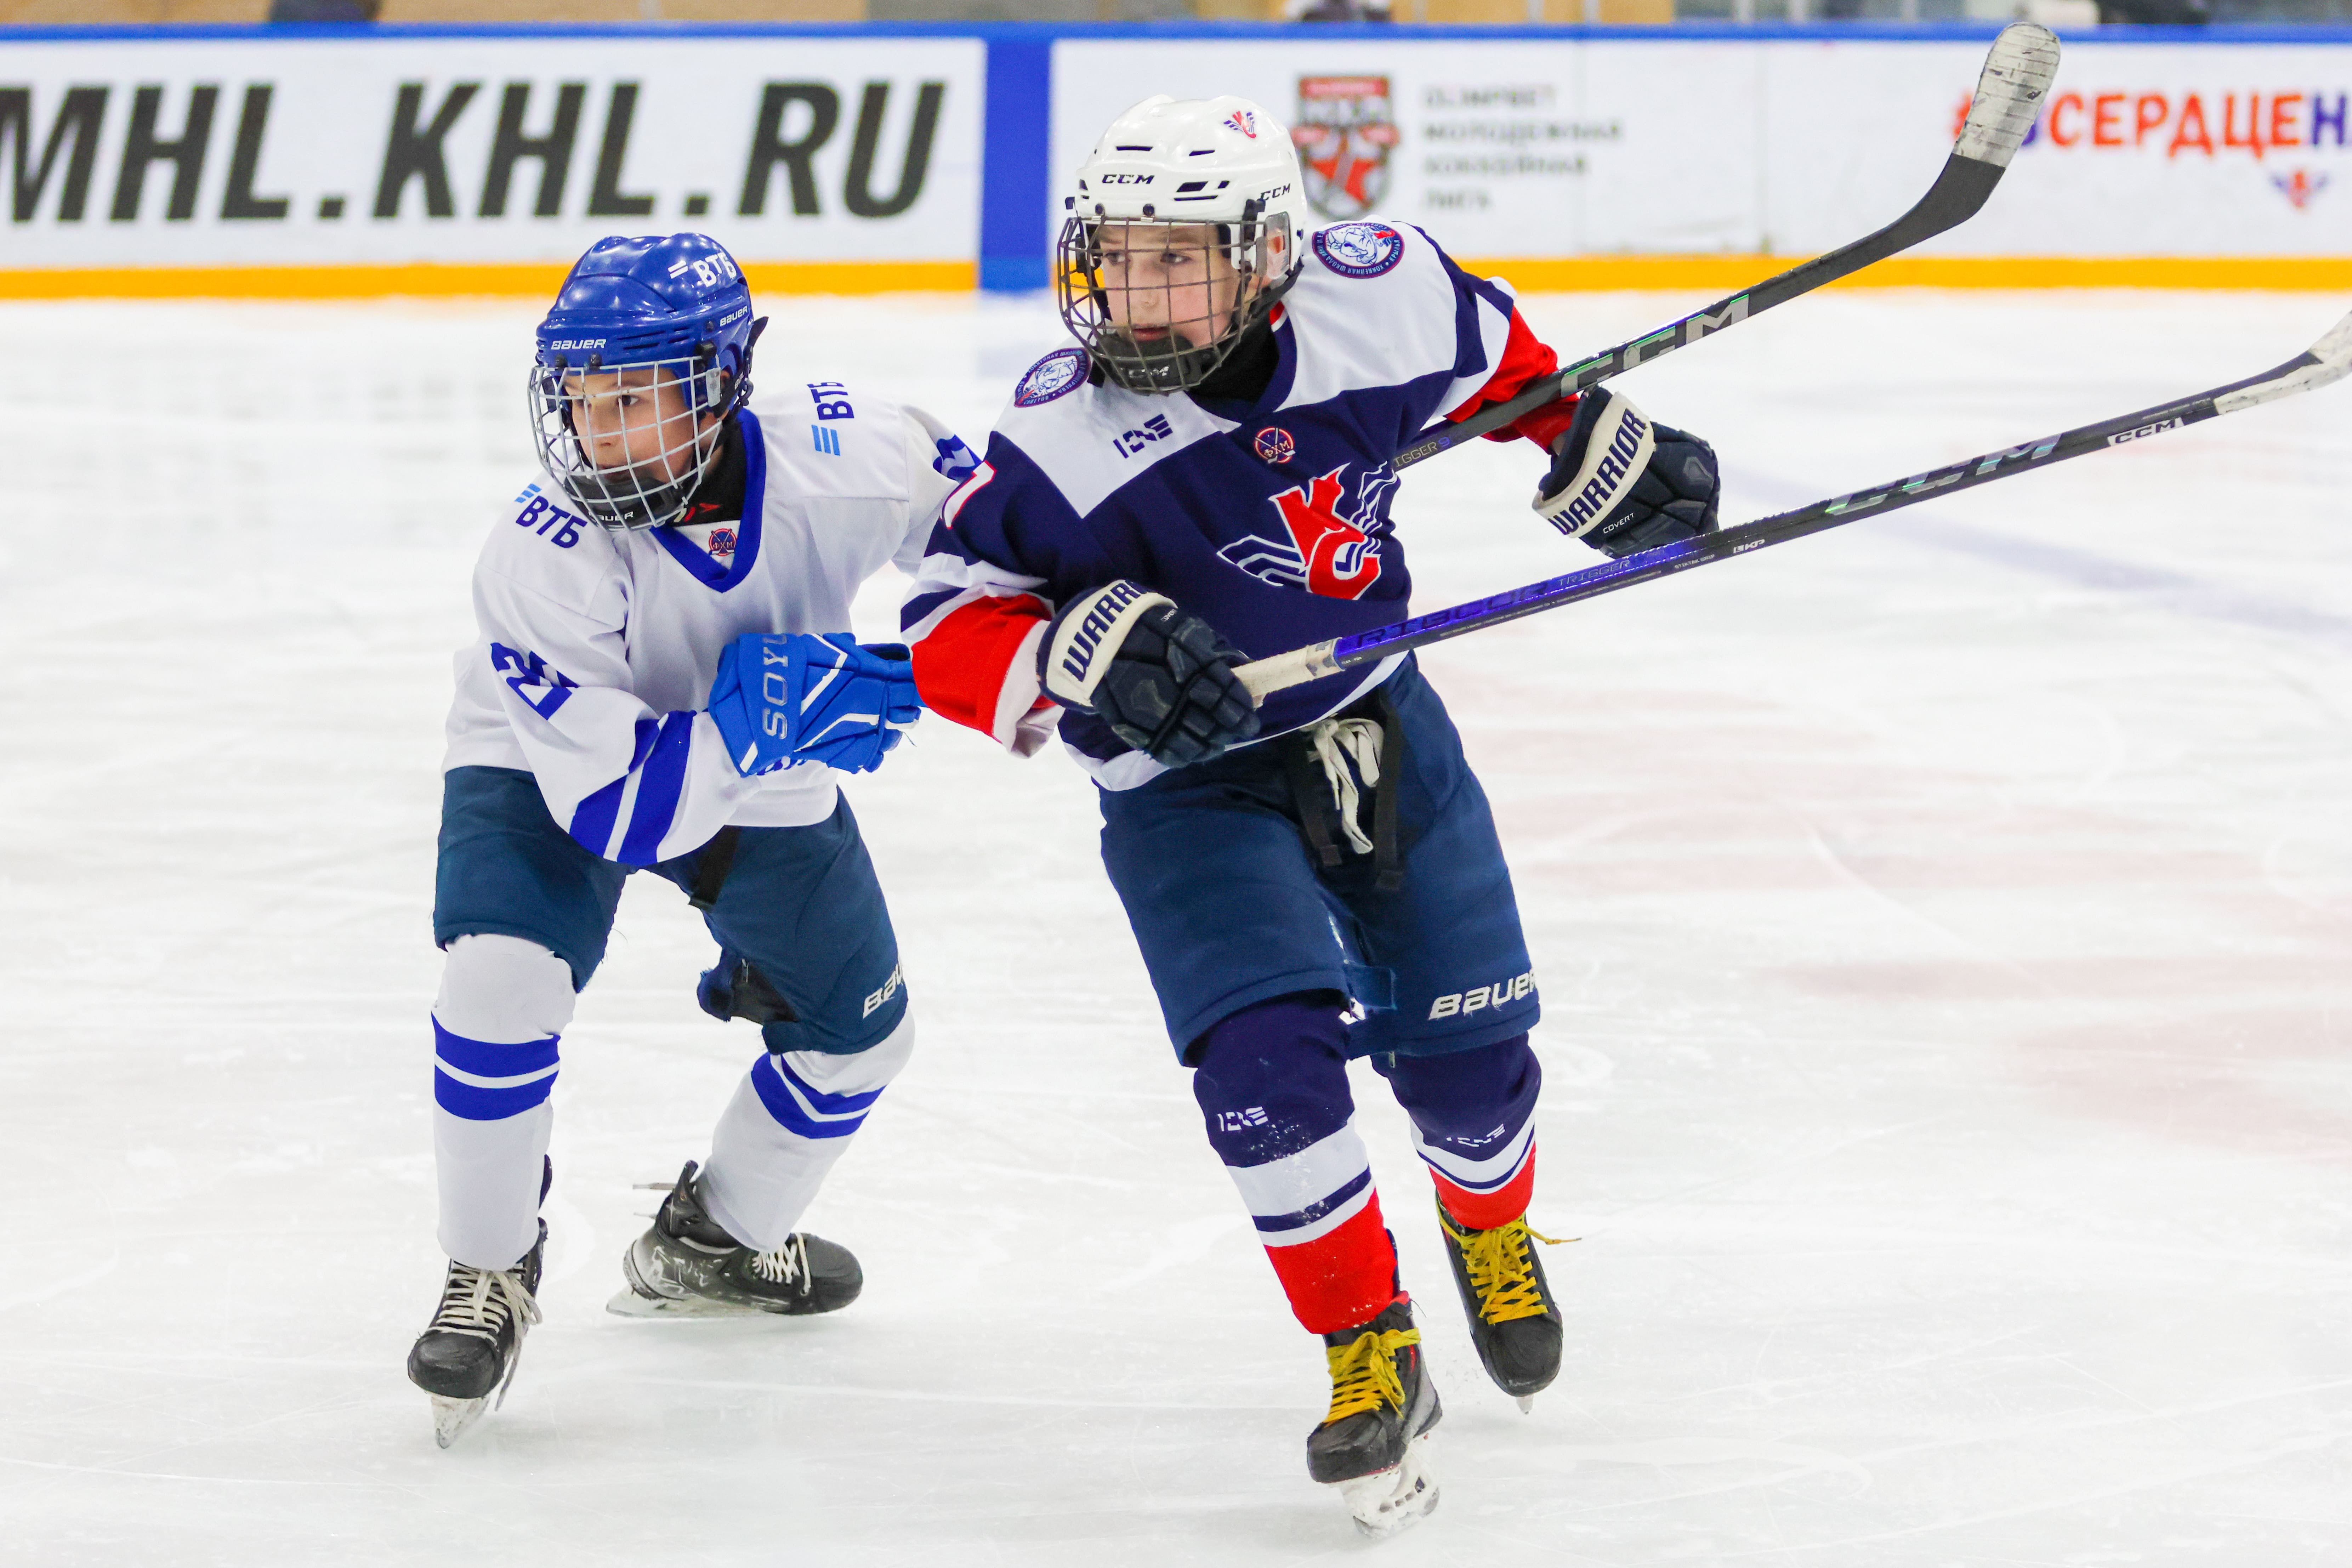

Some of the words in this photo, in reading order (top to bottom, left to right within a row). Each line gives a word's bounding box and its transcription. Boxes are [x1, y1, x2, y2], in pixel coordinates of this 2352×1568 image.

[1101, 174, 1155, 184] CCM
[1260, 183, 1291, 201] CCM
[693, 251, 737, 287] ВТБ
[720, 306, 748, 326] BAUER
[551, 339, 606, 350] BAUER
[1561, 293, 1749, 397] CCM
[2115, 419, 2177, 443] CCM
[1394, 442, 1438, 467] IGGER
[1438, 436, 1451, 447] 9
[1548, 408, 1648, 535] WARRIOR
[516, 495, 588, 549] ВТБ
[589, 510, 634, 522] AUER
[1603, 512, 1635, 534] COVERT
[1559, 559, 1630, 587] TRIGGER
[863, 962, 903, 1019] BAU
